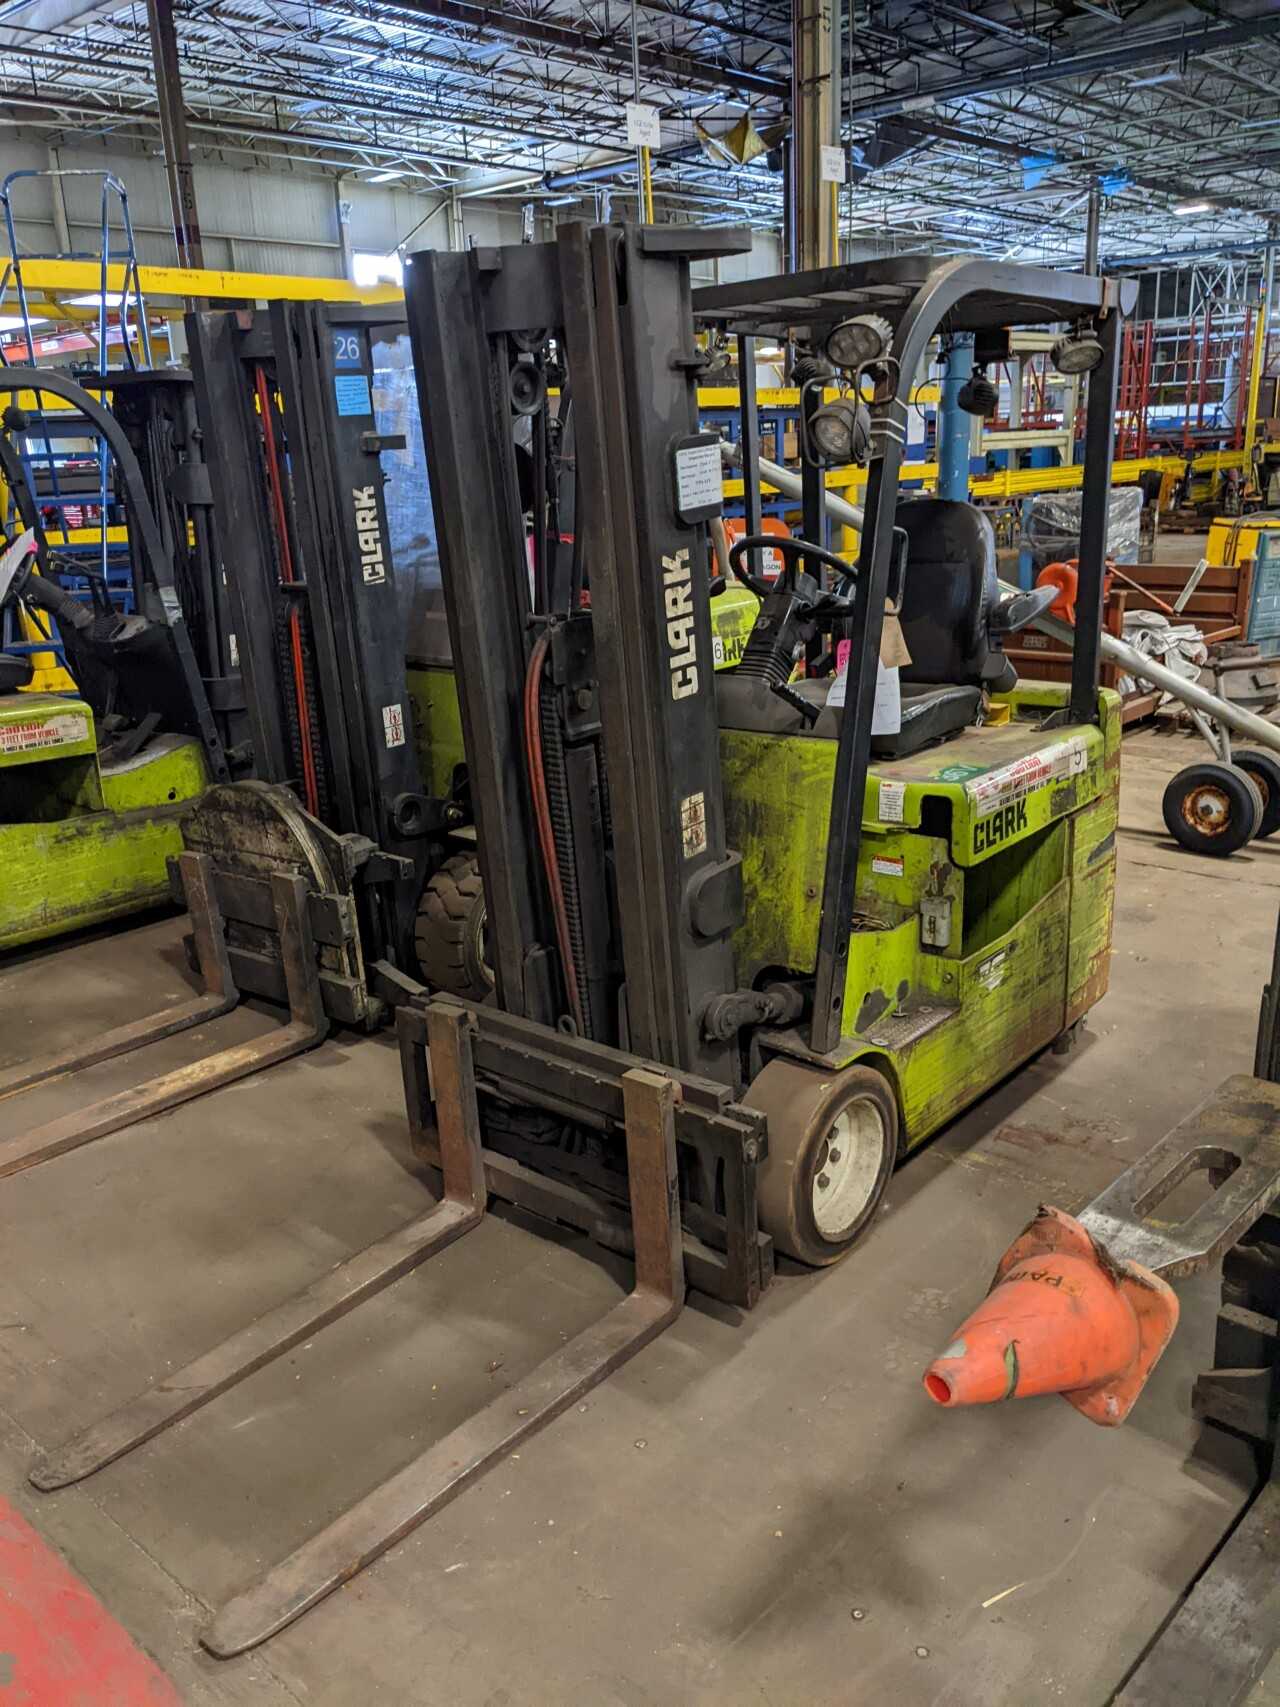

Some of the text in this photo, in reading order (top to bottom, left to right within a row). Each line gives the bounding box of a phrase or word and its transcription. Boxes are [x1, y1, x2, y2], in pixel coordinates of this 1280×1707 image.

[334, 336, 360, 360] 26
[352, 485, 385, 586] CLARK
[662, 548, 699, 700] CLARK
[714, 642, 722, 660] 6
[21, 732, 37, 743] FROM
[38, 728, 59, 738] VEHICLE
[974, 798, 1028, 855] CLARK
